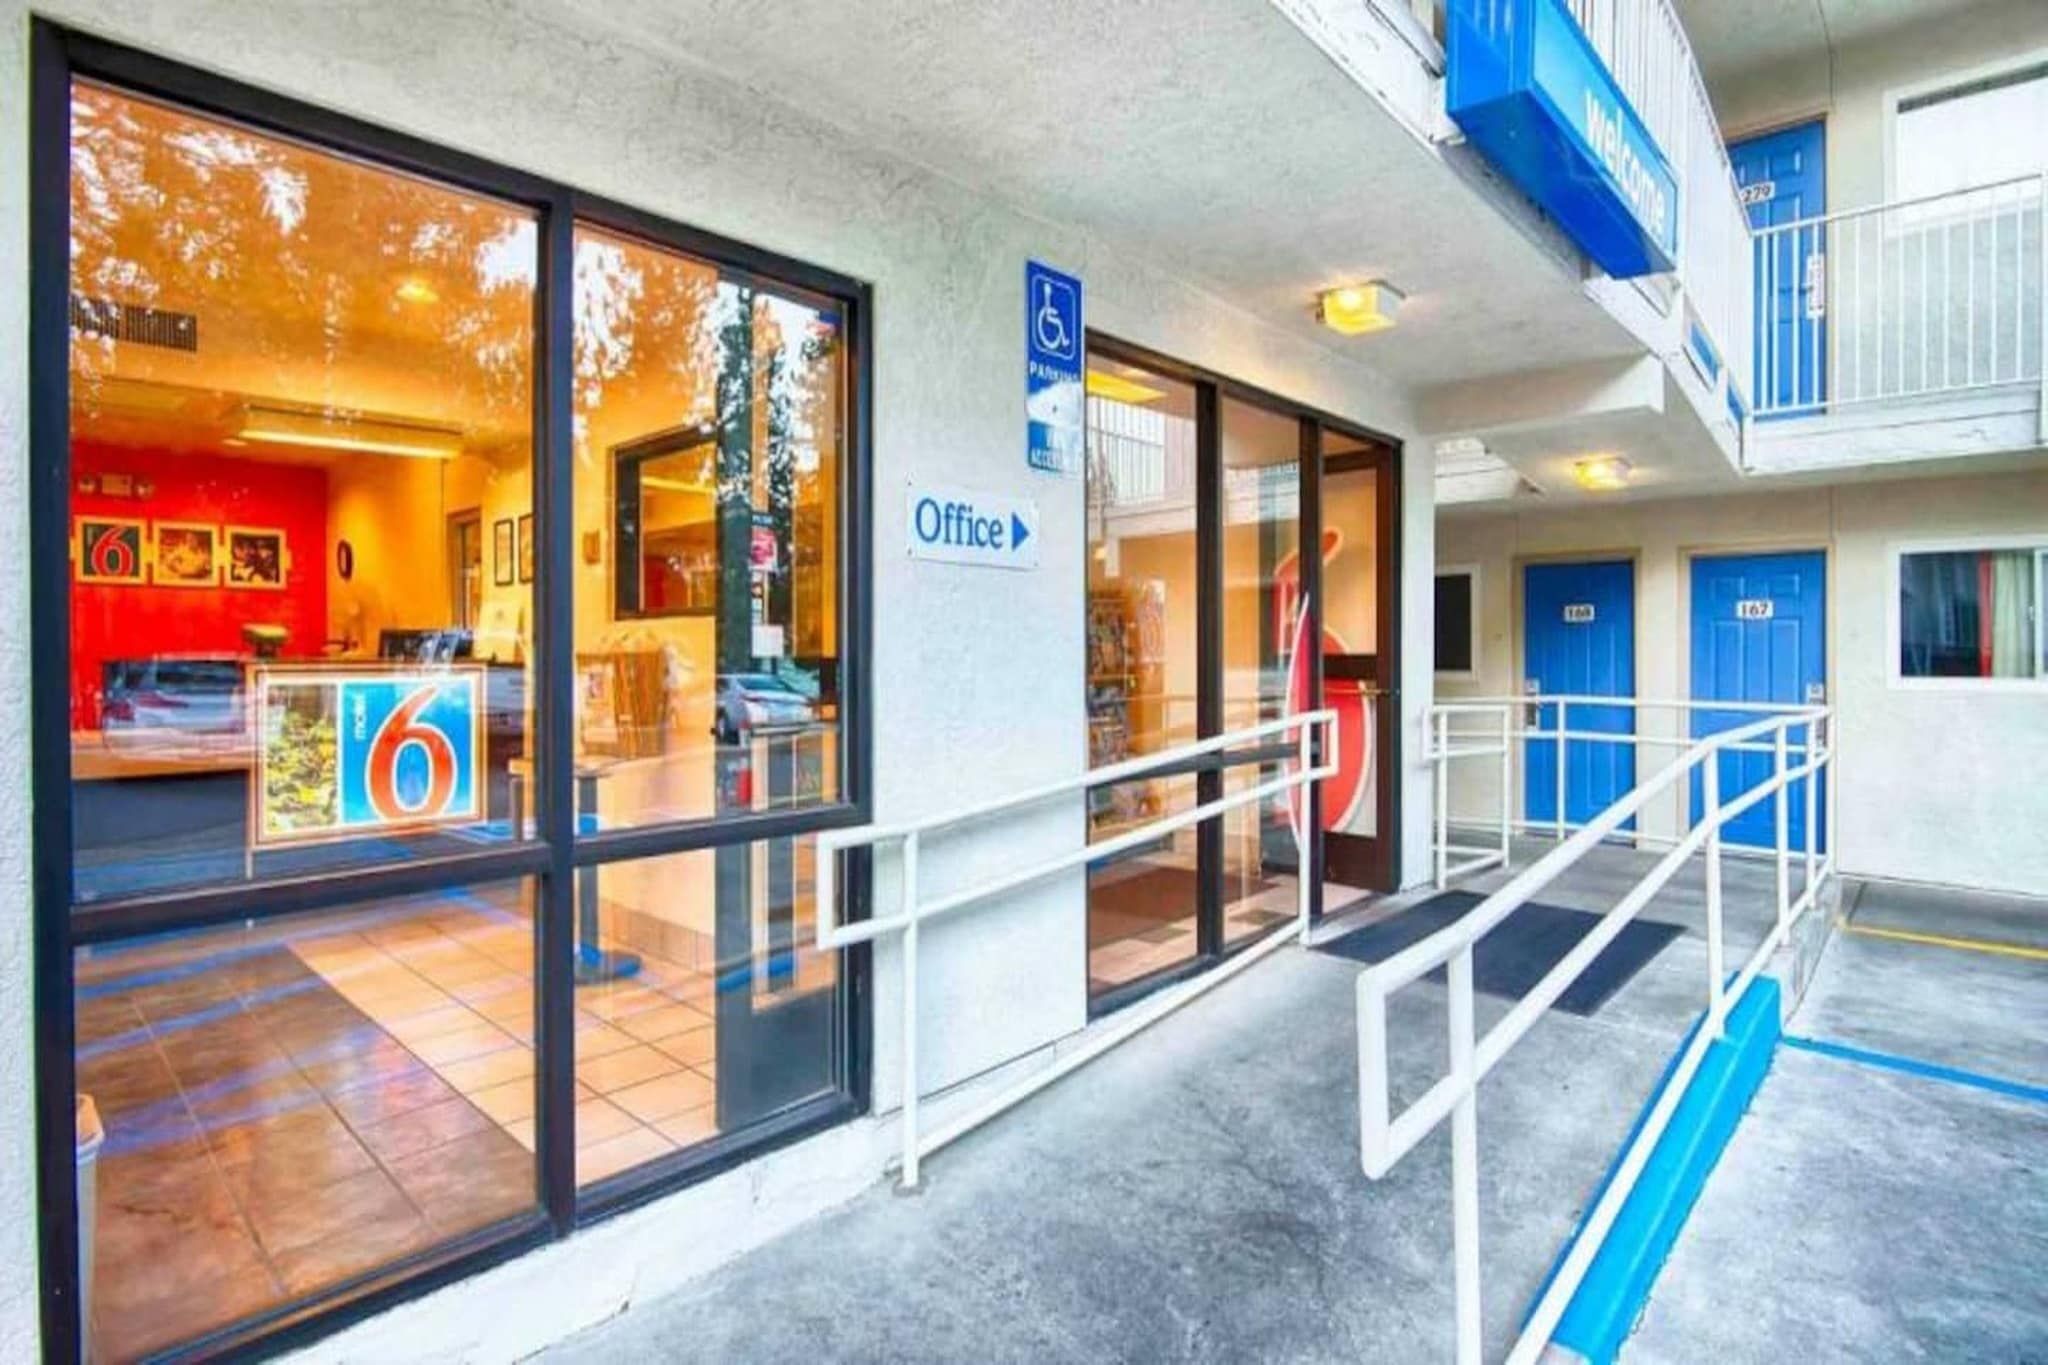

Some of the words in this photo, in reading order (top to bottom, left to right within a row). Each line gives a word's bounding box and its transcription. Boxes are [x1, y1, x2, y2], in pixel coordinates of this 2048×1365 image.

[915, 498, 1004, 549] Office
[91, 527, 133, 576] 6
[1742, 602, 1768, 616] 167
[364, 685, 458, 818] 6
